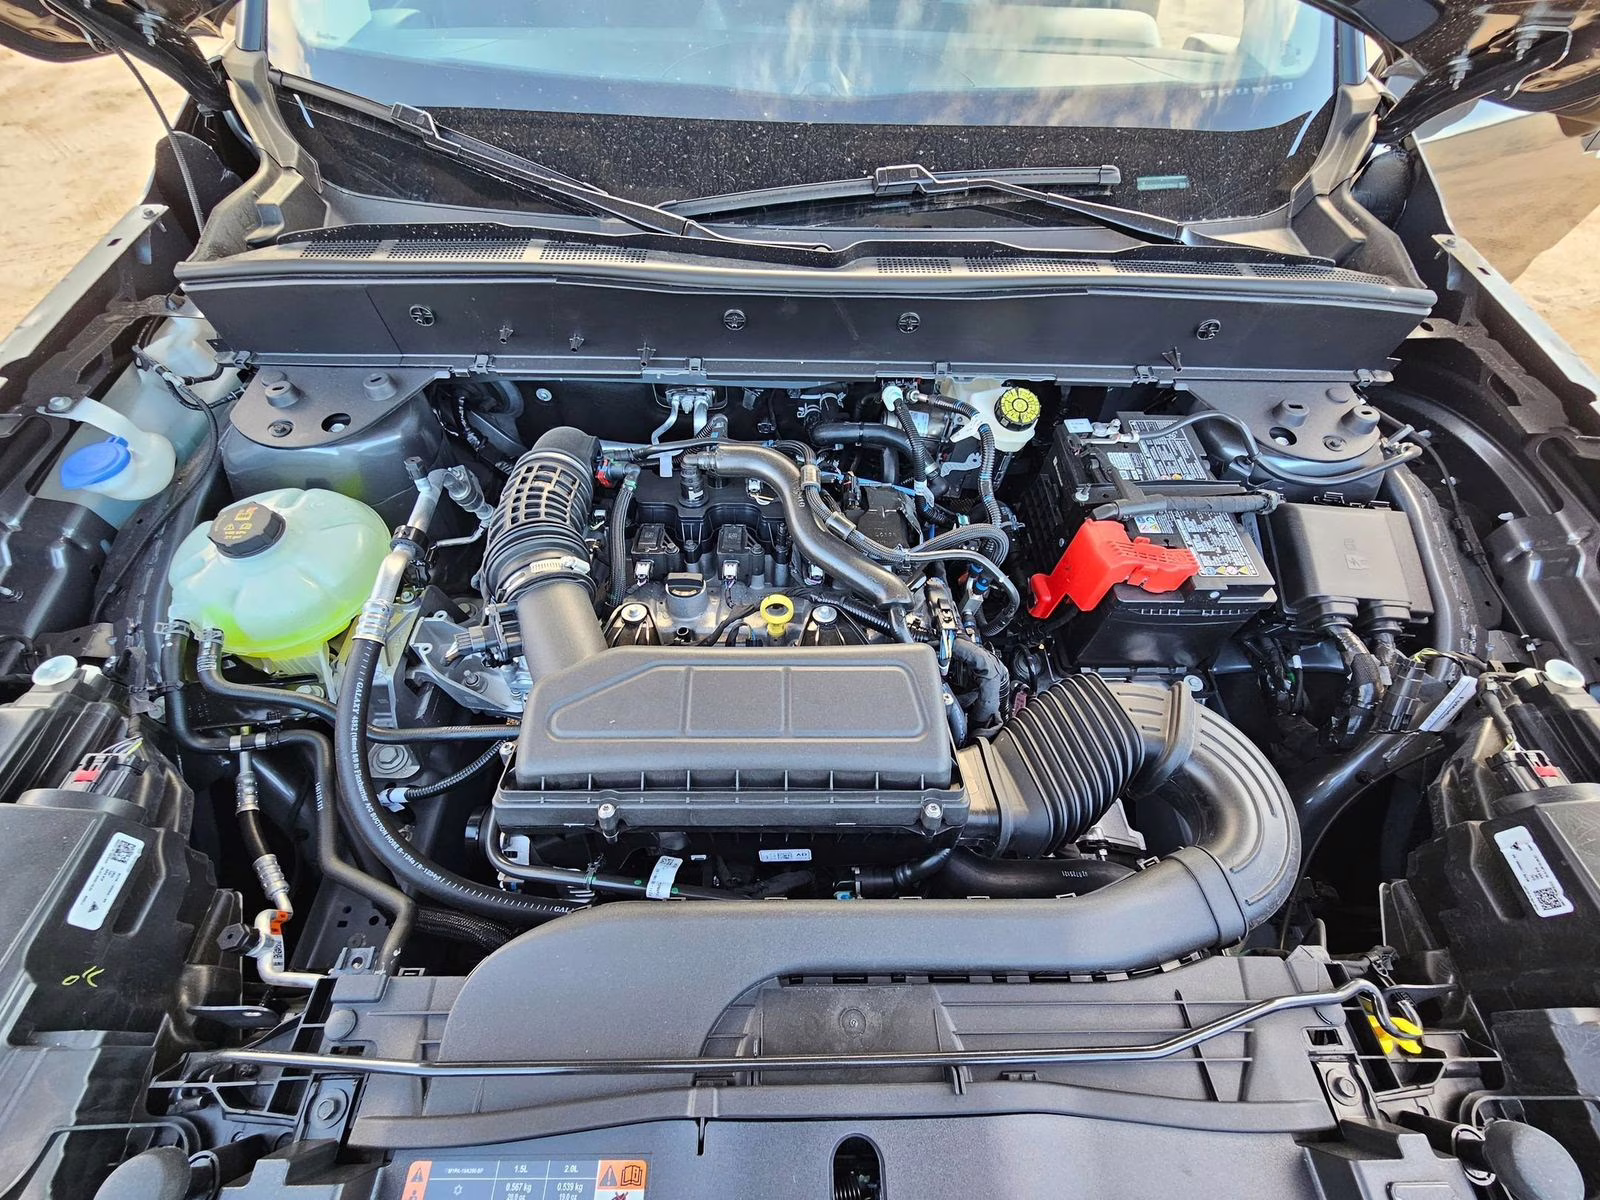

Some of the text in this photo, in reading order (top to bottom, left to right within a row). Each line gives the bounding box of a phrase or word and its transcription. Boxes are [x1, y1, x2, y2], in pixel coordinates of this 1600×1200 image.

[352, 681, 364, 715] GALAXY
[385, 833, 400, 851] HOSE
[514, 1164, 528, 1174] 1.5L
[564, 1164, 578, 1174] 2.0L
[524, 1183, 533, 1194] kg
[575, 1183, 584, 1194] kg
